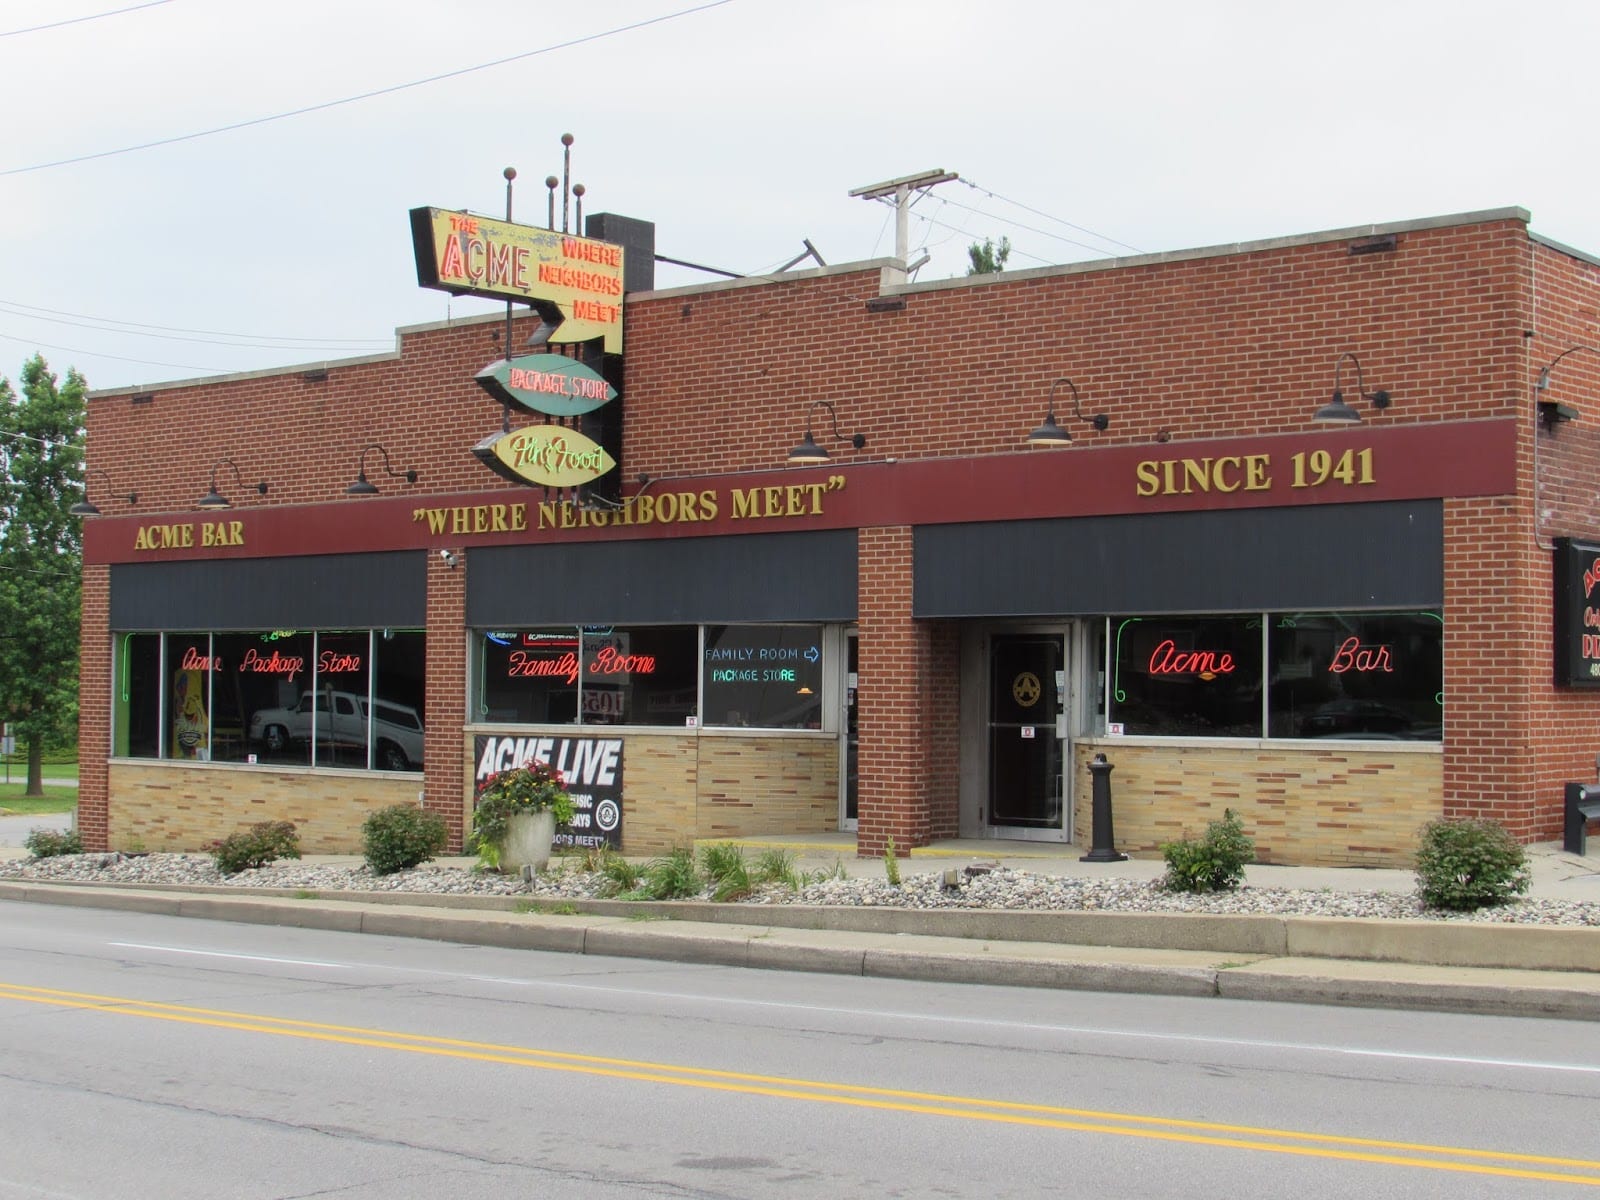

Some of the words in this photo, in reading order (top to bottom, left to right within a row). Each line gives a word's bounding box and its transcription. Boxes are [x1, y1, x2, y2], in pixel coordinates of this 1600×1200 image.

[449, 216, 479, 235] THE
[440, 234, 531, 291] ACME
[561, 236, 621, 268] WHERE
[538, 263, 622, 296] NEIGHBORS
[573, 299, 622, 324] MEET
[509, 367, 568, 396] PACKAGE
[572, 376, 610, 401] STORE
[551, 436, 604, 475] Food
[1136, 453, 1273, 497] SINCE
[1290, 447, 1377, 488] 1941
[537, 490, 719, 529] NEIGHBORS
[134, 523, 195, 550] ACME
[200, 520, 245, 546] BAR
[182, 647, 223, 672] Acme
[239, 648, 304, 684] Package
[316, 650, 361, 674] Store
[508, 650, 580, 686] Family
[590, 646, 656, 674] Room
[704, 648, 754, 661] FAMILY
[759, 648, 799, 661] ROOM
[1149, 639, 1236, 674] Acme
[1328, 636, 1394, 674] Bar
[713, 668, 759, 682] PACKAGE
[763, 668, 796, 682] STORE
[476, 736, 554, 781] ACME
[556, 738, 622, 786] LIVE
